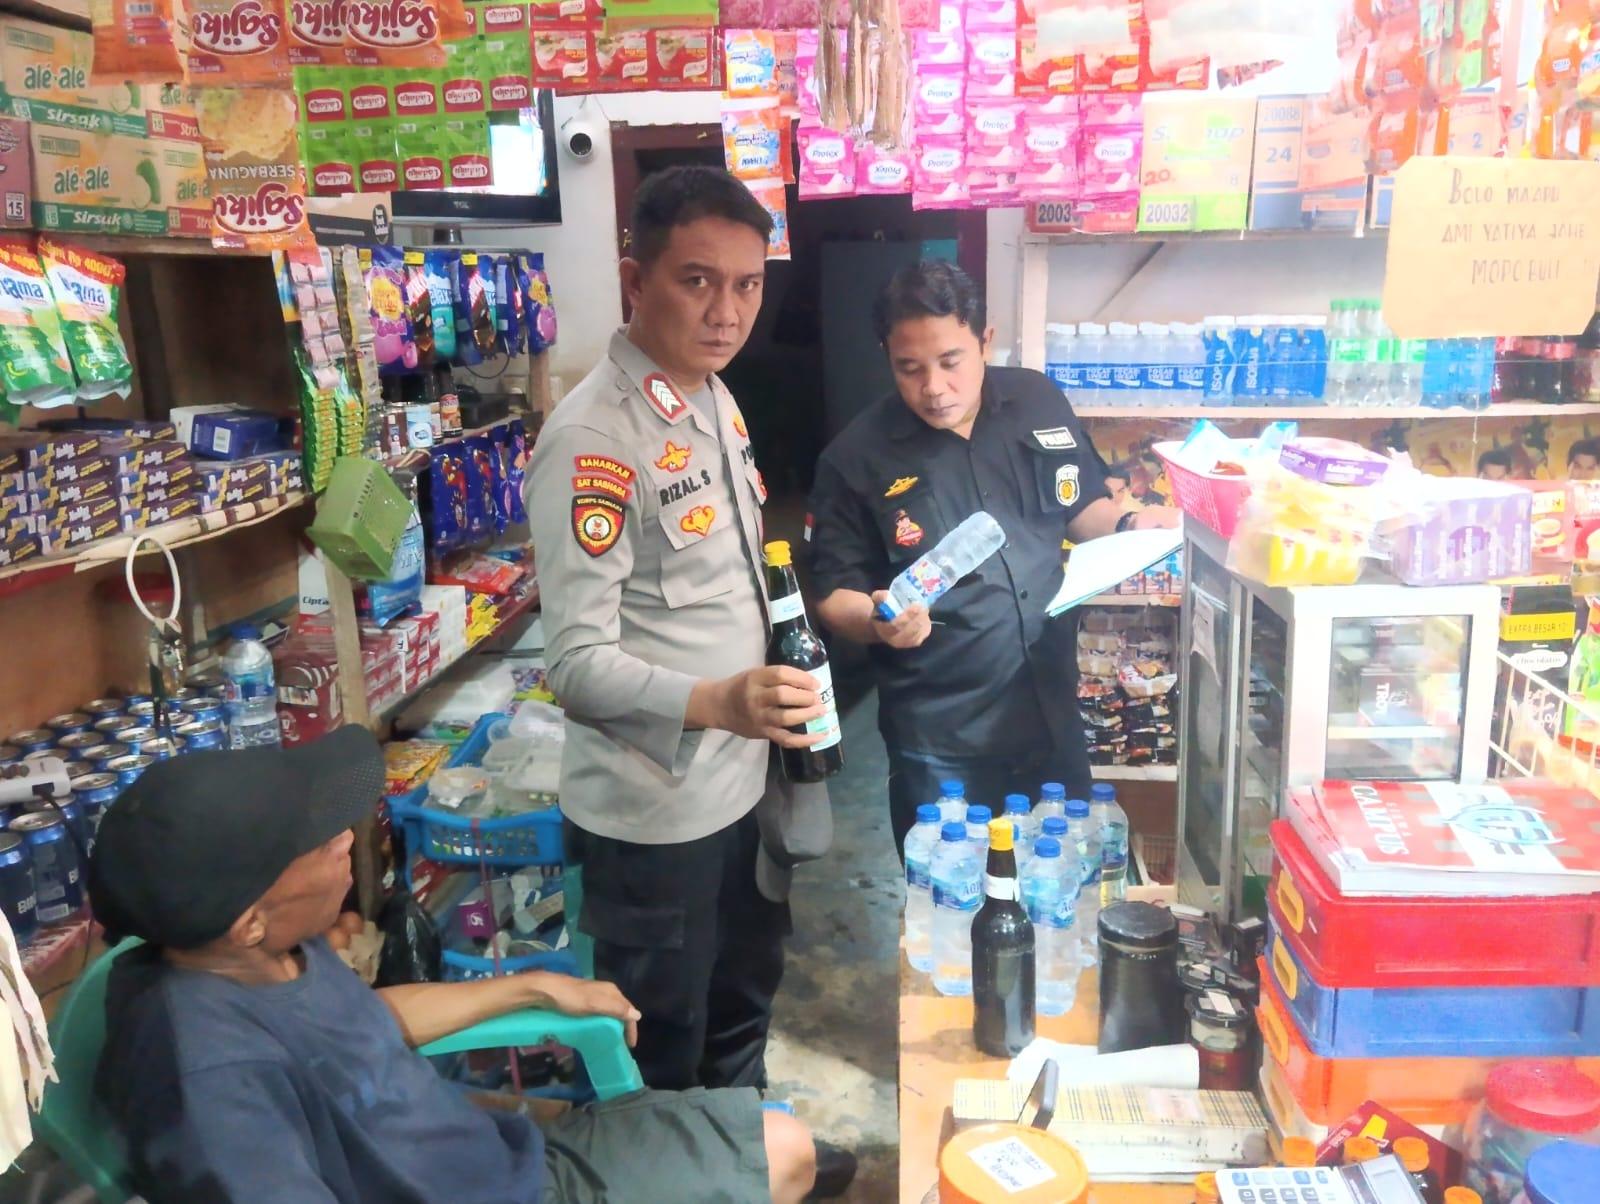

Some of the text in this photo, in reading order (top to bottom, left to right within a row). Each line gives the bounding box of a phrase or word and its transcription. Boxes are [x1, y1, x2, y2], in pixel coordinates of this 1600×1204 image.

[1265, 146, 1293, 163] 24
[208, 163, 295, 180] SERBAGUNA
[8, 201, 24, 216] 15
[211, 183, 304, 226] Sajiku
[1038, 203, 1080, 223] 2003
[1145, 204, 1189, 224] 20032
[580, 458, 630, 479] BAHARKAM
[577, 478, 592, 488] SAT
[701, 469, 711, 486] S
[302, 596, 329, 606] Cipta
[1350, 785, 1410, 856] CAMPUS
